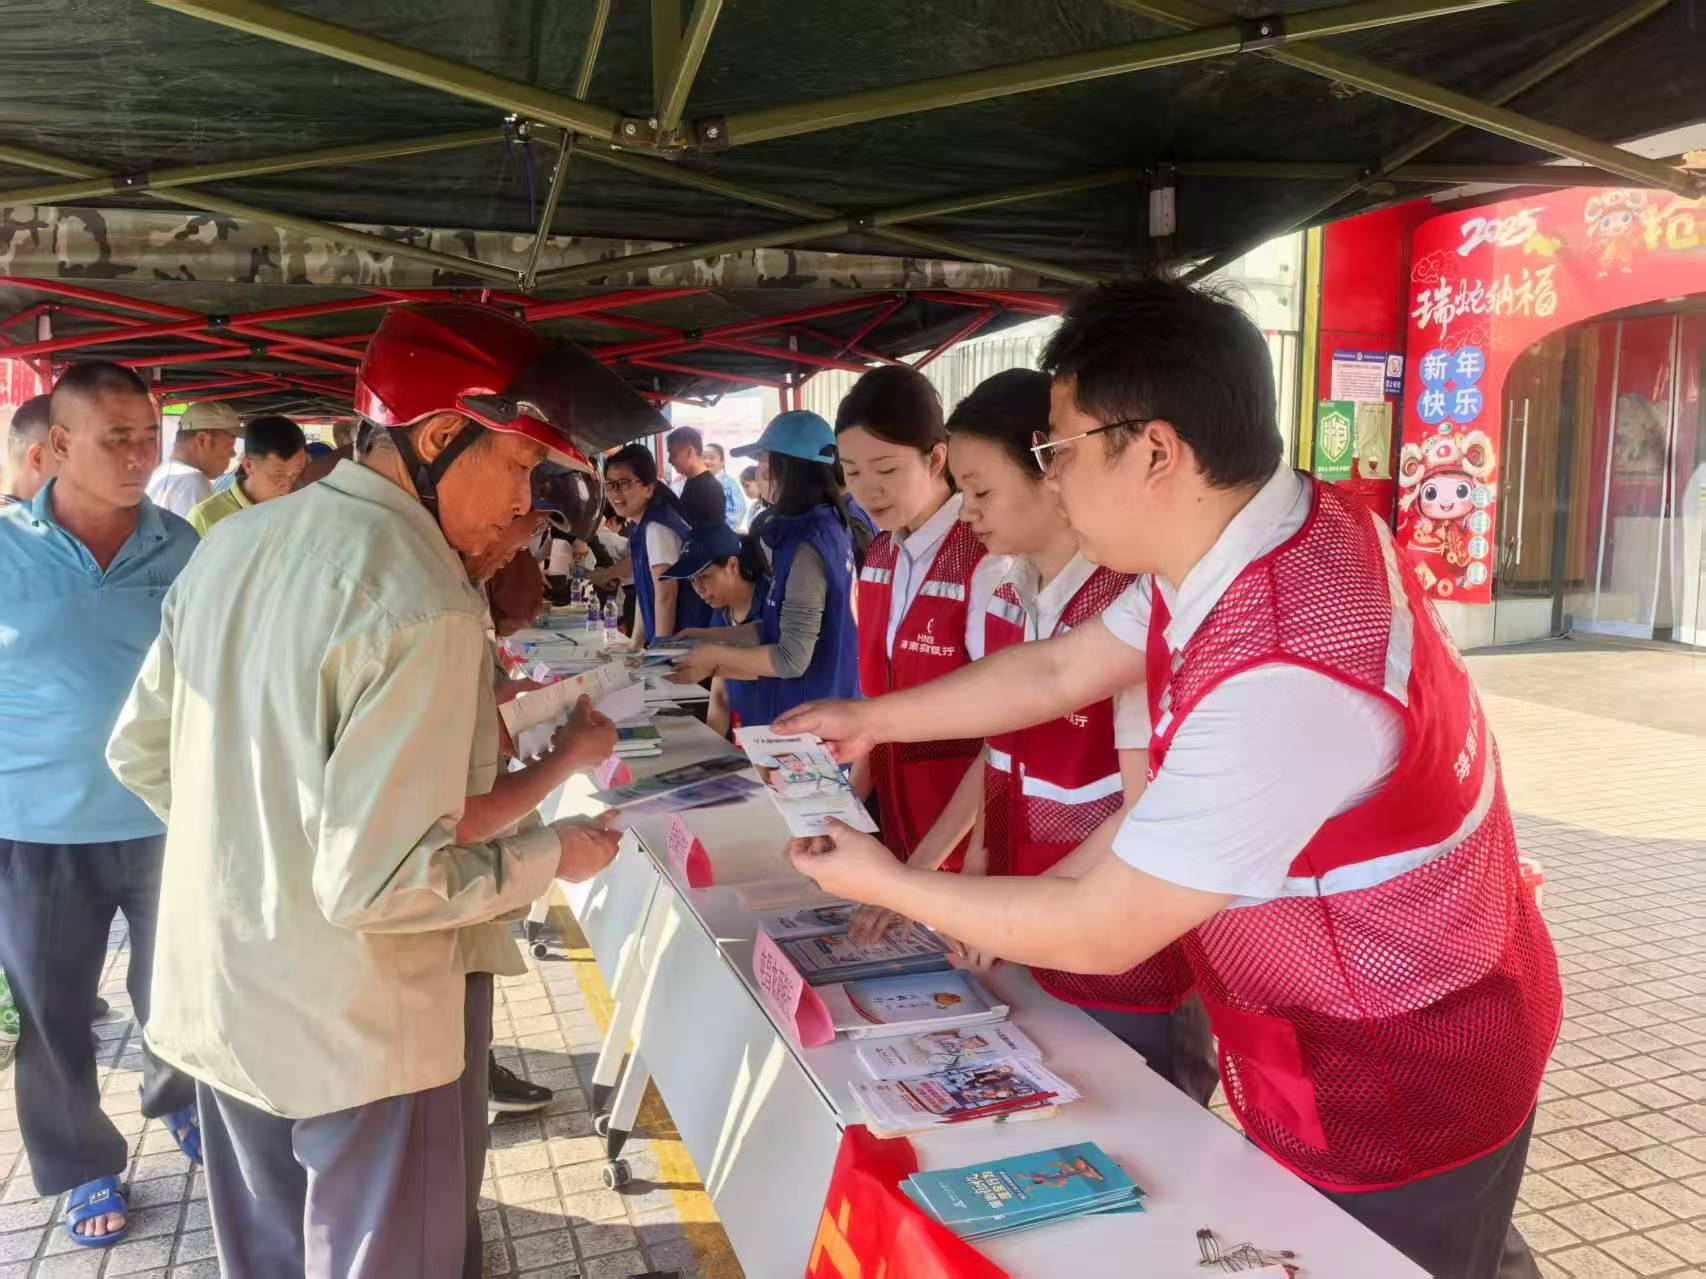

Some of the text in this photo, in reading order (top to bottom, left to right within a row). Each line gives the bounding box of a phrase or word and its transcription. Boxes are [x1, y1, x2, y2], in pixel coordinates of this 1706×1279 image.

[1457, 206, 1548, 256] 2025
[1411, 264, 1558, 341] 瑞蛇纳福
[1424, 351, 1480, 380] 新年
[1422, 389, 1478, 417] 快乐
